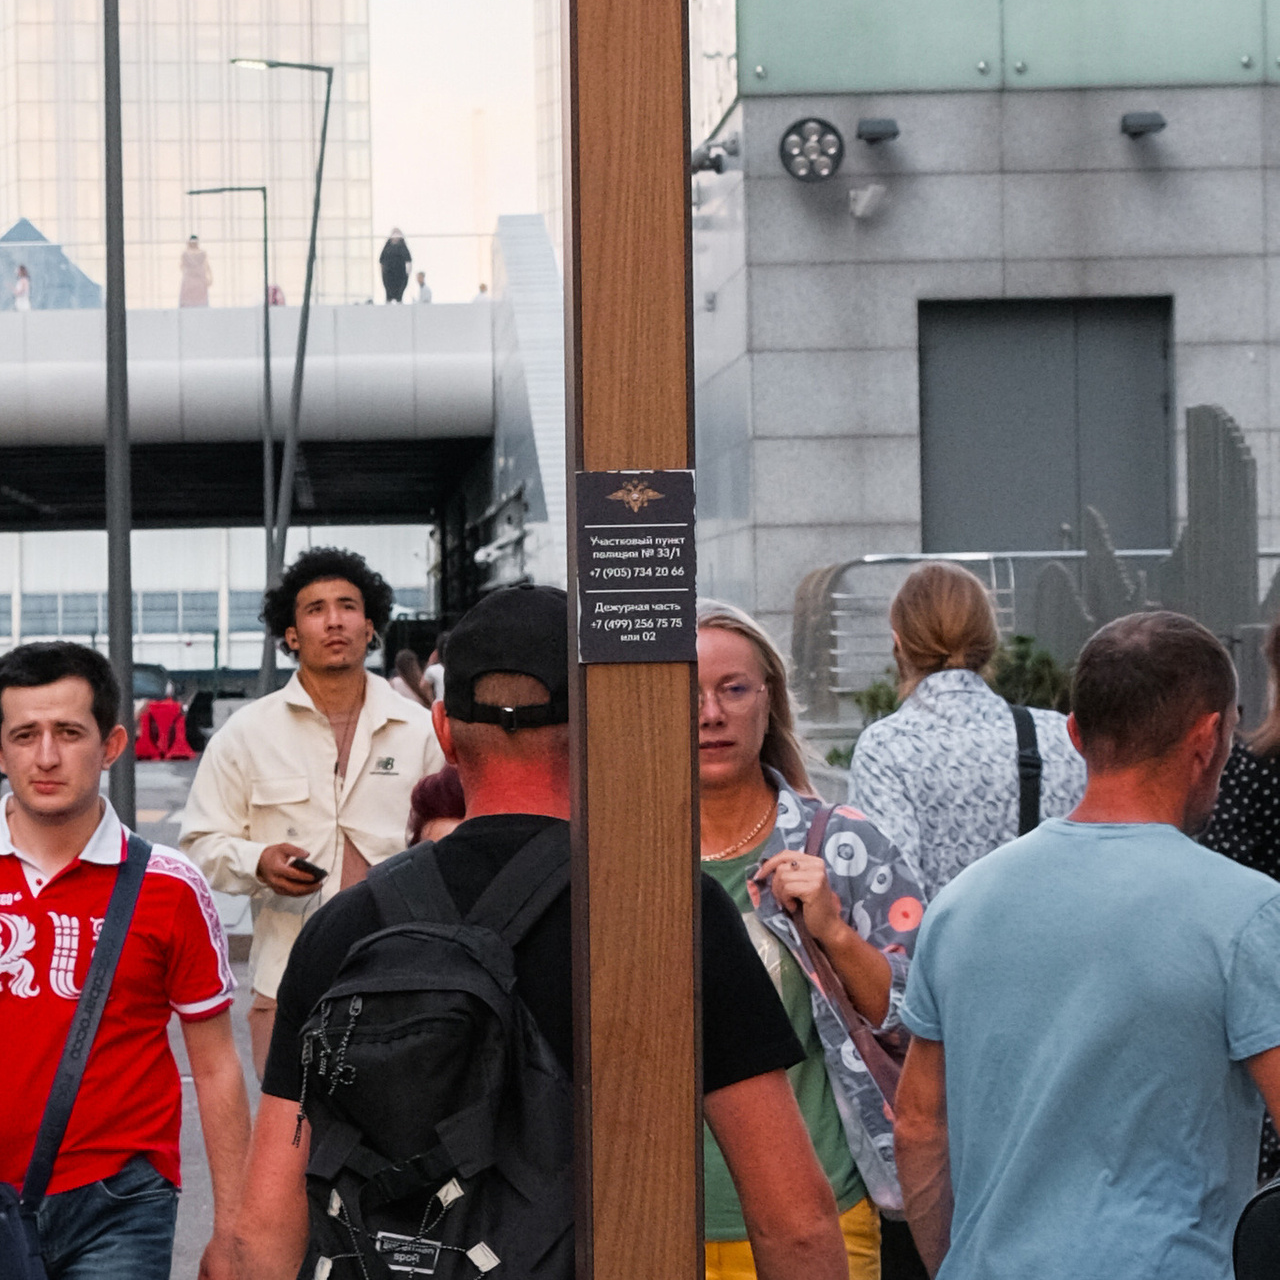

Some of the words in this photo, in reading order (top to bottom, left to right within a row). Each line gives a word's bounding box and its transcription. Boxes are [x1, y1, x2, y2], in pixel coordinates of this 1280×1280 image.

[589, 535, 653, 547] Участковый
[655, 537, 686, 548] пункт
[592, 550, 639, 560] полиции
[641, 548, 655, 559] №
[656, 546, 681, 561] 33/1
[589, 567, 601, 579] +7
[602, 567, 632, 580] (905)
[633, 567, 653, 577] 734
[655, 566, 669, 577] 20
[670, 566, 685, 577] 66
[594, 602, 650, 614] Дежурная
[651, 603, 682, 611] часть
[590, 619, 602, 630] +7
[604, 619, 633, 632] (499)
[634, 618, 654, 629] 256
[656, 618, 669, 628] 75
[669, 617, 683, 628] 75
[620, 633, 640, 642] или
[642, 631, 657, 642] 02
